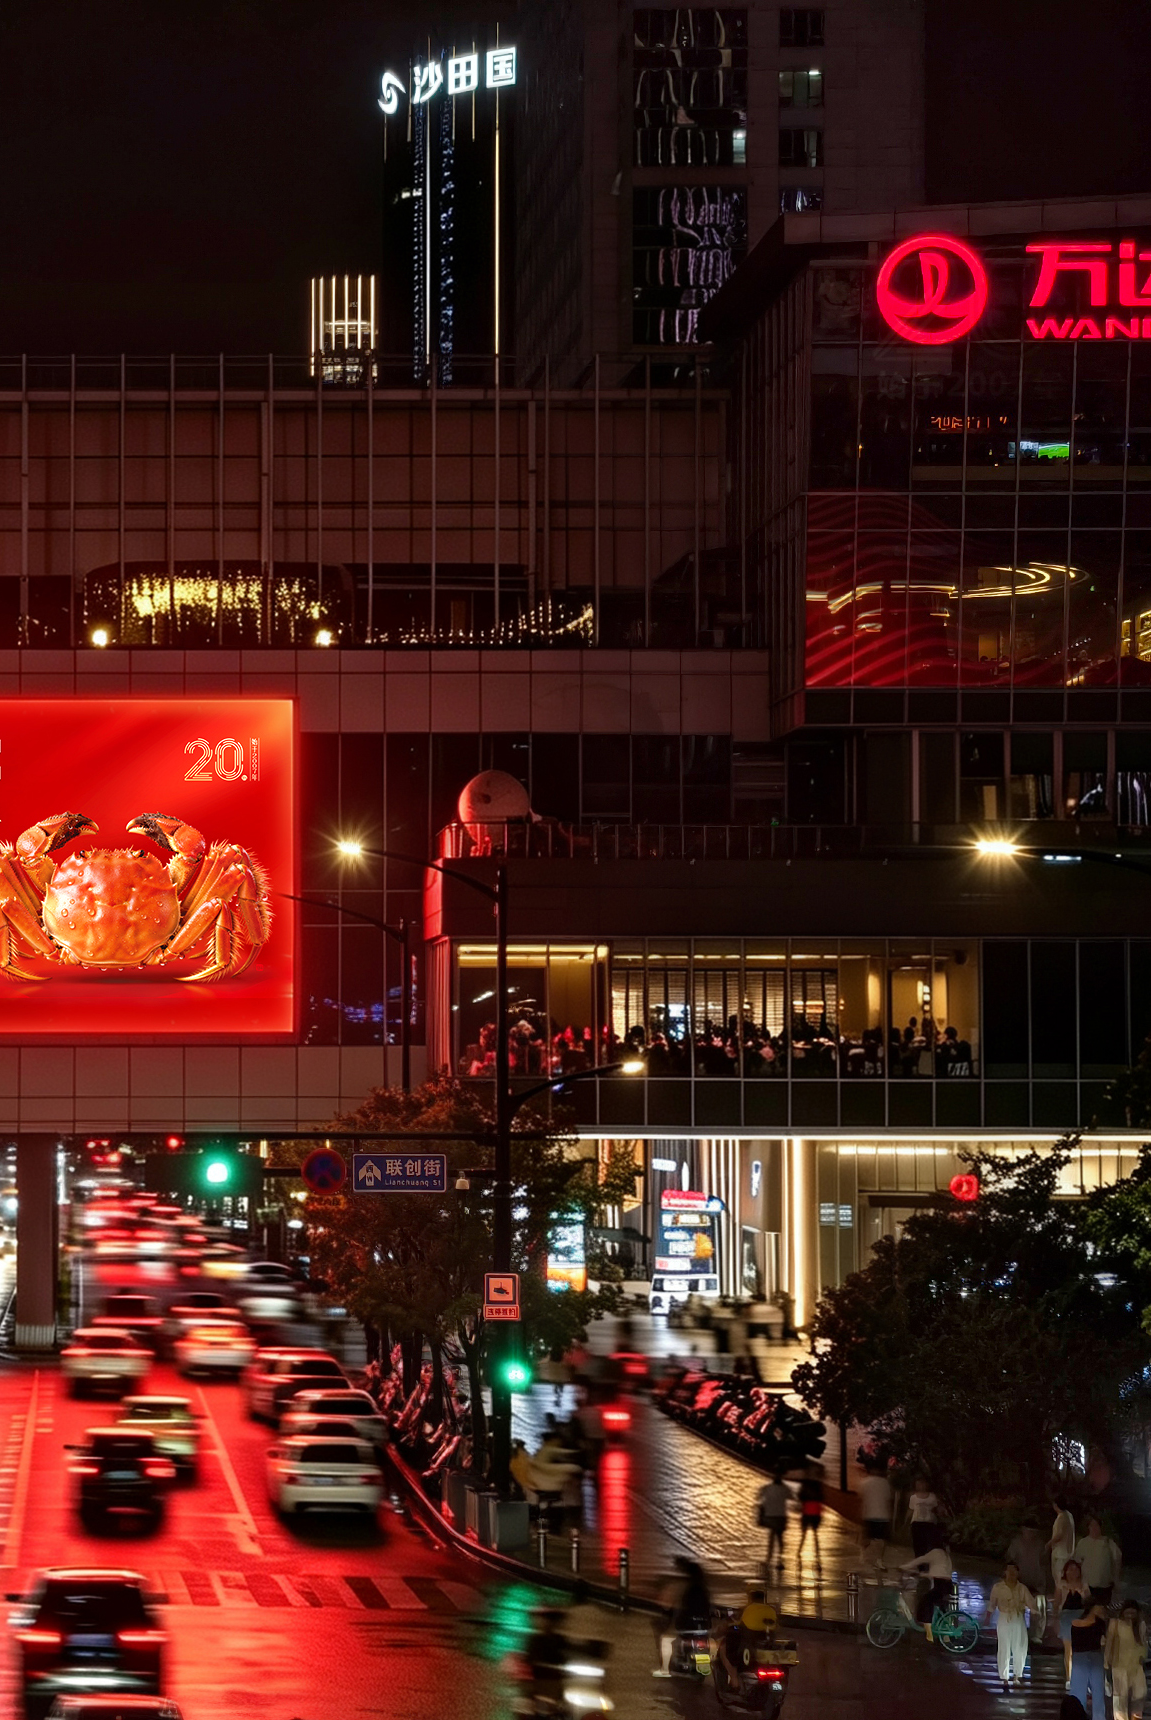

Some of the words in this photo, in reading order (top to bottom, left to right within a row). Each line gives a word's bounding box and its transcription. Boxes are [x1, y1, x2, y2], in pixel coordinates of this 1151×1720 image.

[1025, 318, 1151, 339] WAN
[385, 1159, 441, 1177] 联创街
[384, 1179, 429, 1187] Lianchuang
